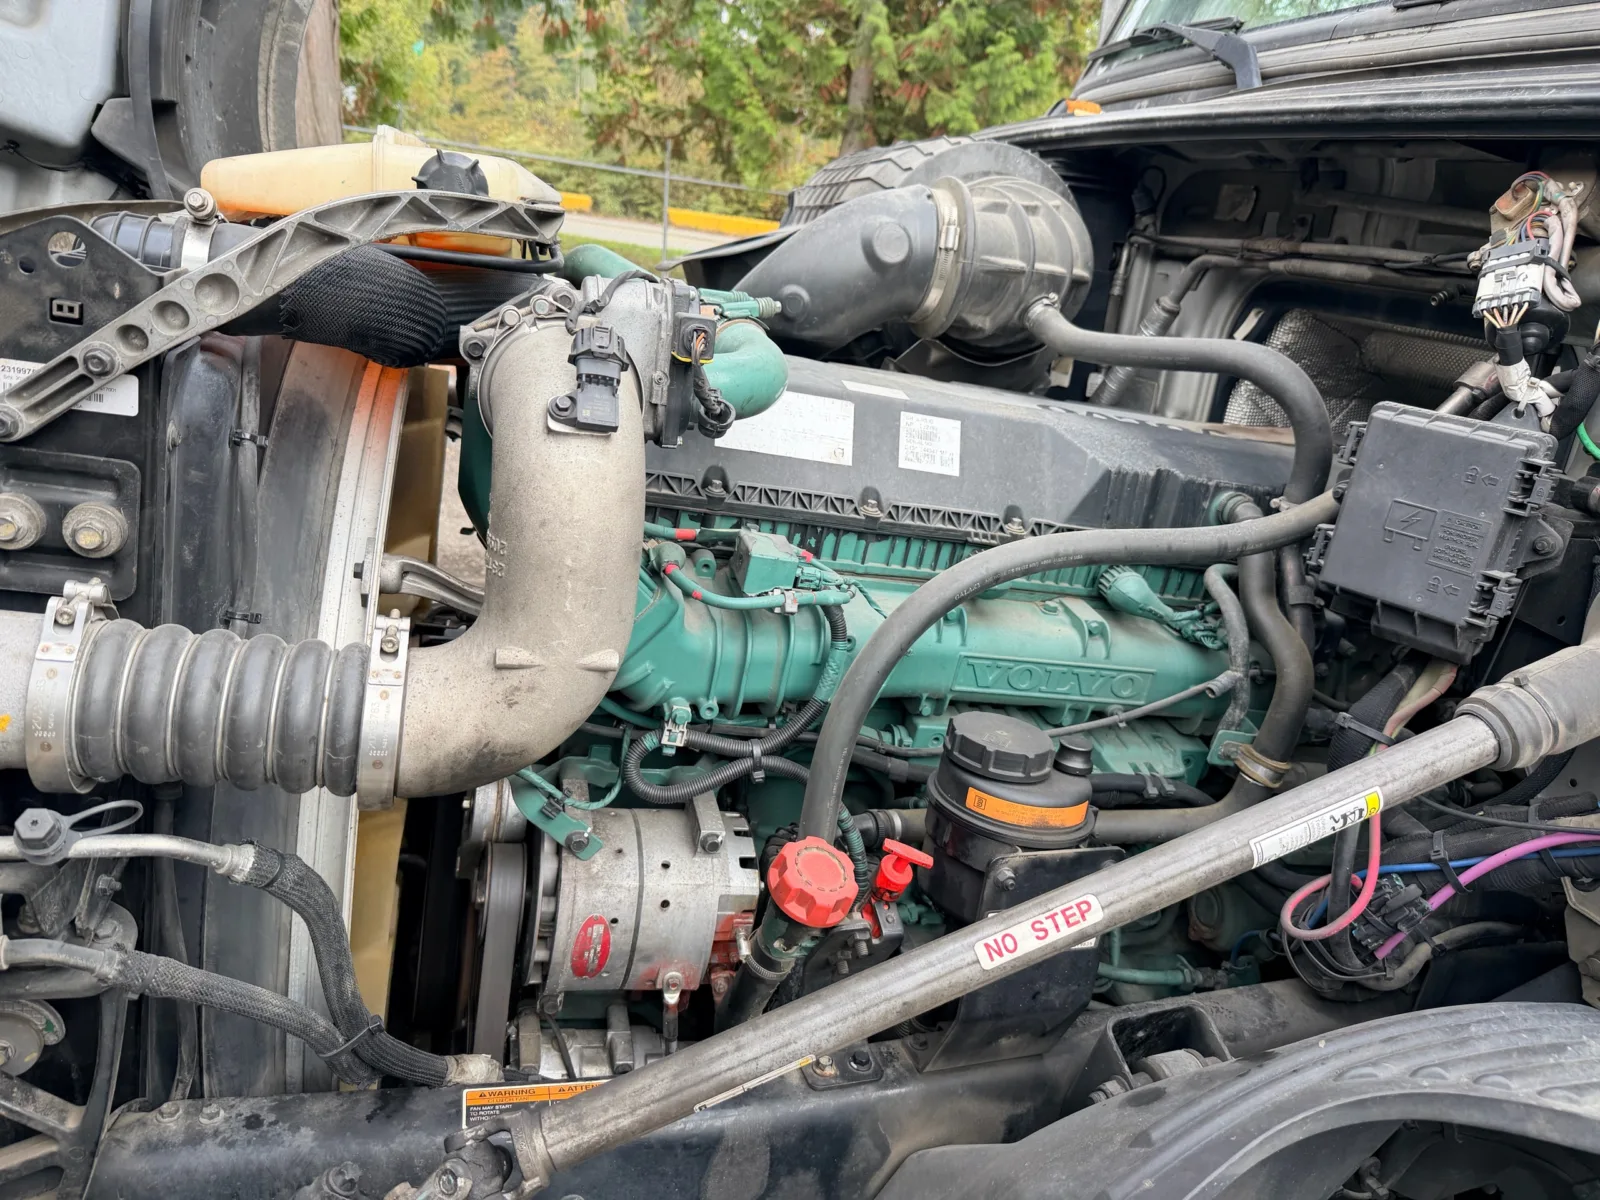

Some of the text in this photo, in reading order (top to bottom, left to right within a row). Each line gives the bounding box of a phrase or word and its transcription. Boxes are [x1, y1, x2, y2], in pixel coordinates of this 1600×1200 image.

[966, 659, 1145, 699] VOLVO
[983, 900, 1092, 962] NO STEP
[488, 1088, 536, 1097] WARNING
